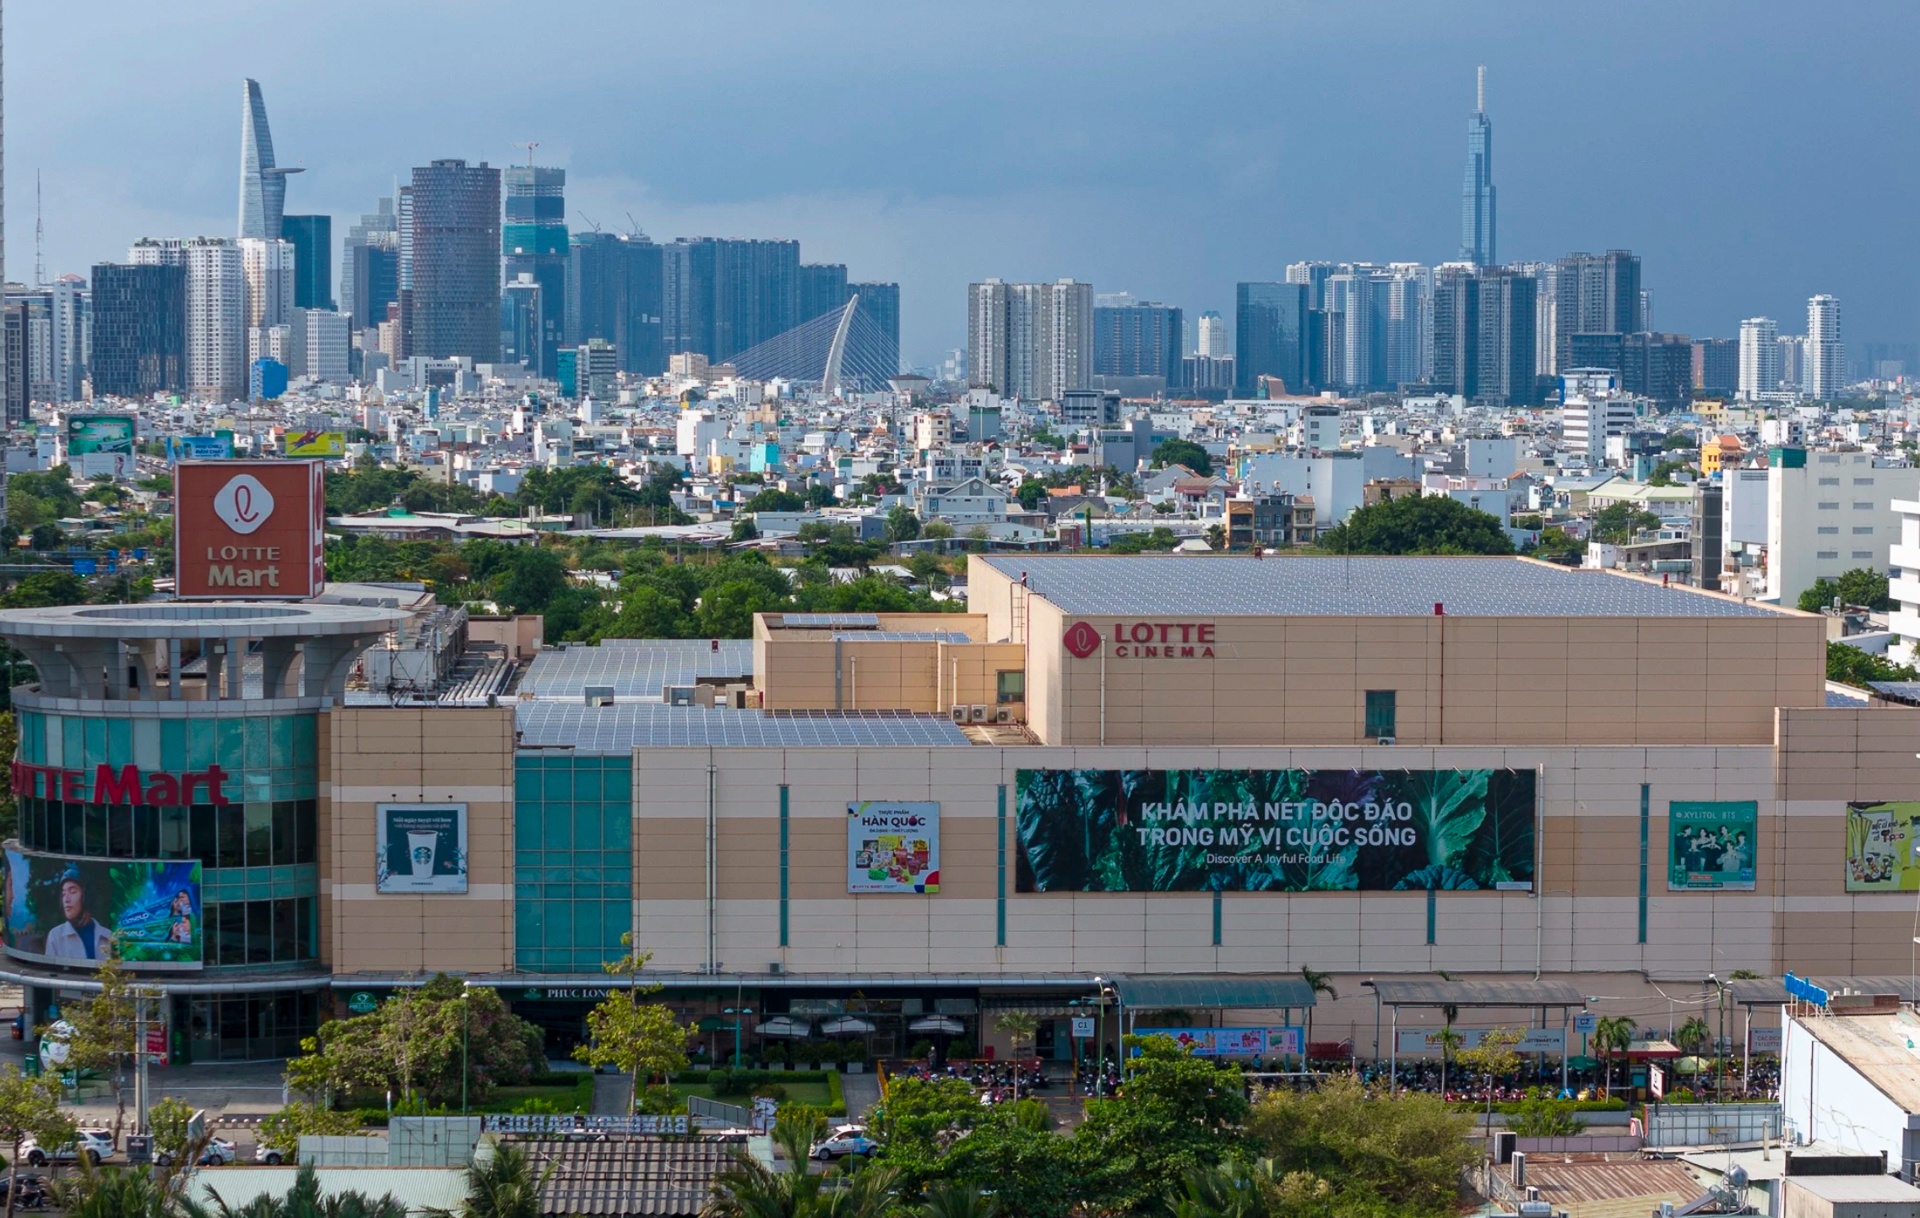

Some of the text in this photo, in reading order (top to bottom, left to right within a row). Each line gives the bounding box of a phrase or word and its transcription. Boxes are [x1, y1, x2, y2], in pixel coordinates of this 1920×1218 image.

[207, 545, 280, 561] LOTTE
[207, 564, 280, 587] Mart
[1115, 622, 1215, 643] LOTTE
[1115, 645, 1215, 658] CINEMA
[93, 763, 229, 807] Mart
[1141, 797, 1412, 825] KHÁM PHÁ NÉT ĐỘC ĐÁO
[1683, 811, 1717, 819] XYLITOL
[862, 812, 926, 828] HÀN QUỐC
[1136, 822, 1416, 850] TRONG MỸ VỊ CUỘC SỐNG
[1206, 853, 1346, 866] Discover A Joyful Food Life
[1078, 1021, 1088, 1029] C1
